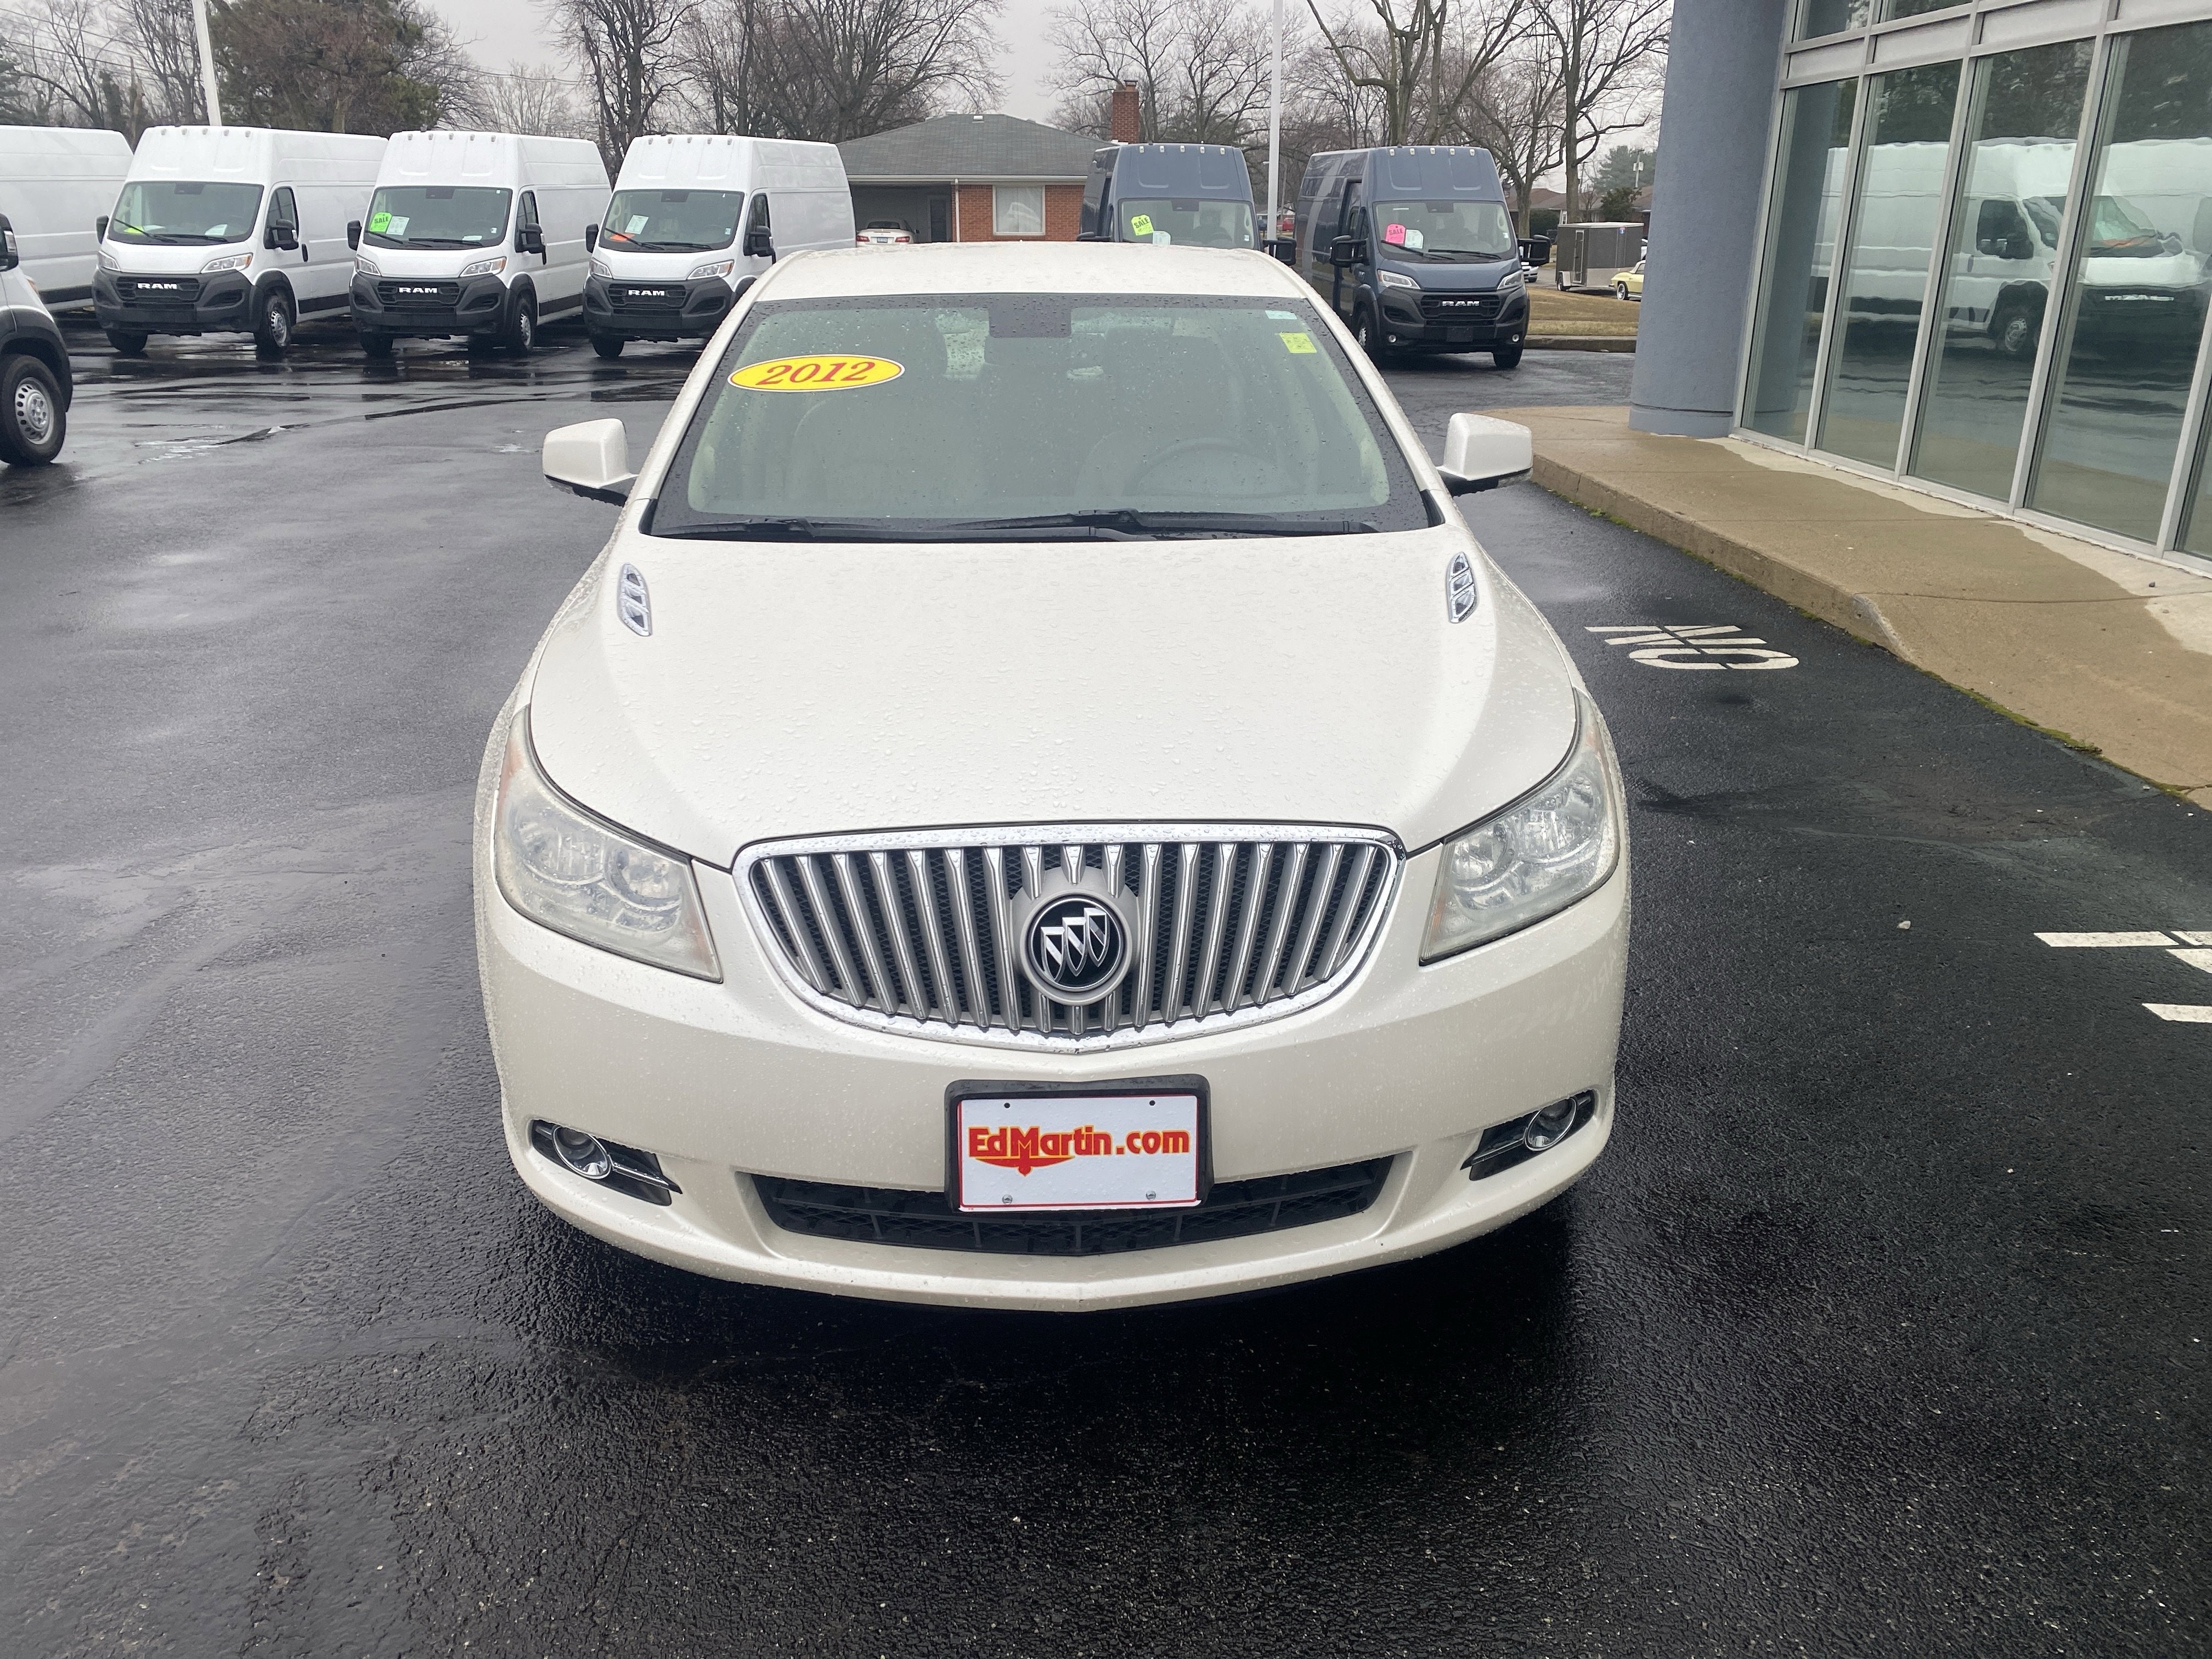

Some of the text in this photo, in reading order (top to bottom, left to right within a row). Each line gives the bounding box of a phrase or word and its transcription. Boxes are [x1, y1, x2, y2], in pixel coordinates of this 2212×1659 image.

[1133, 217, 1150, 229] SALE
[755, 362, 876, 386] 2012
[968, 1125, 1190, 1166] EdMartin.com
